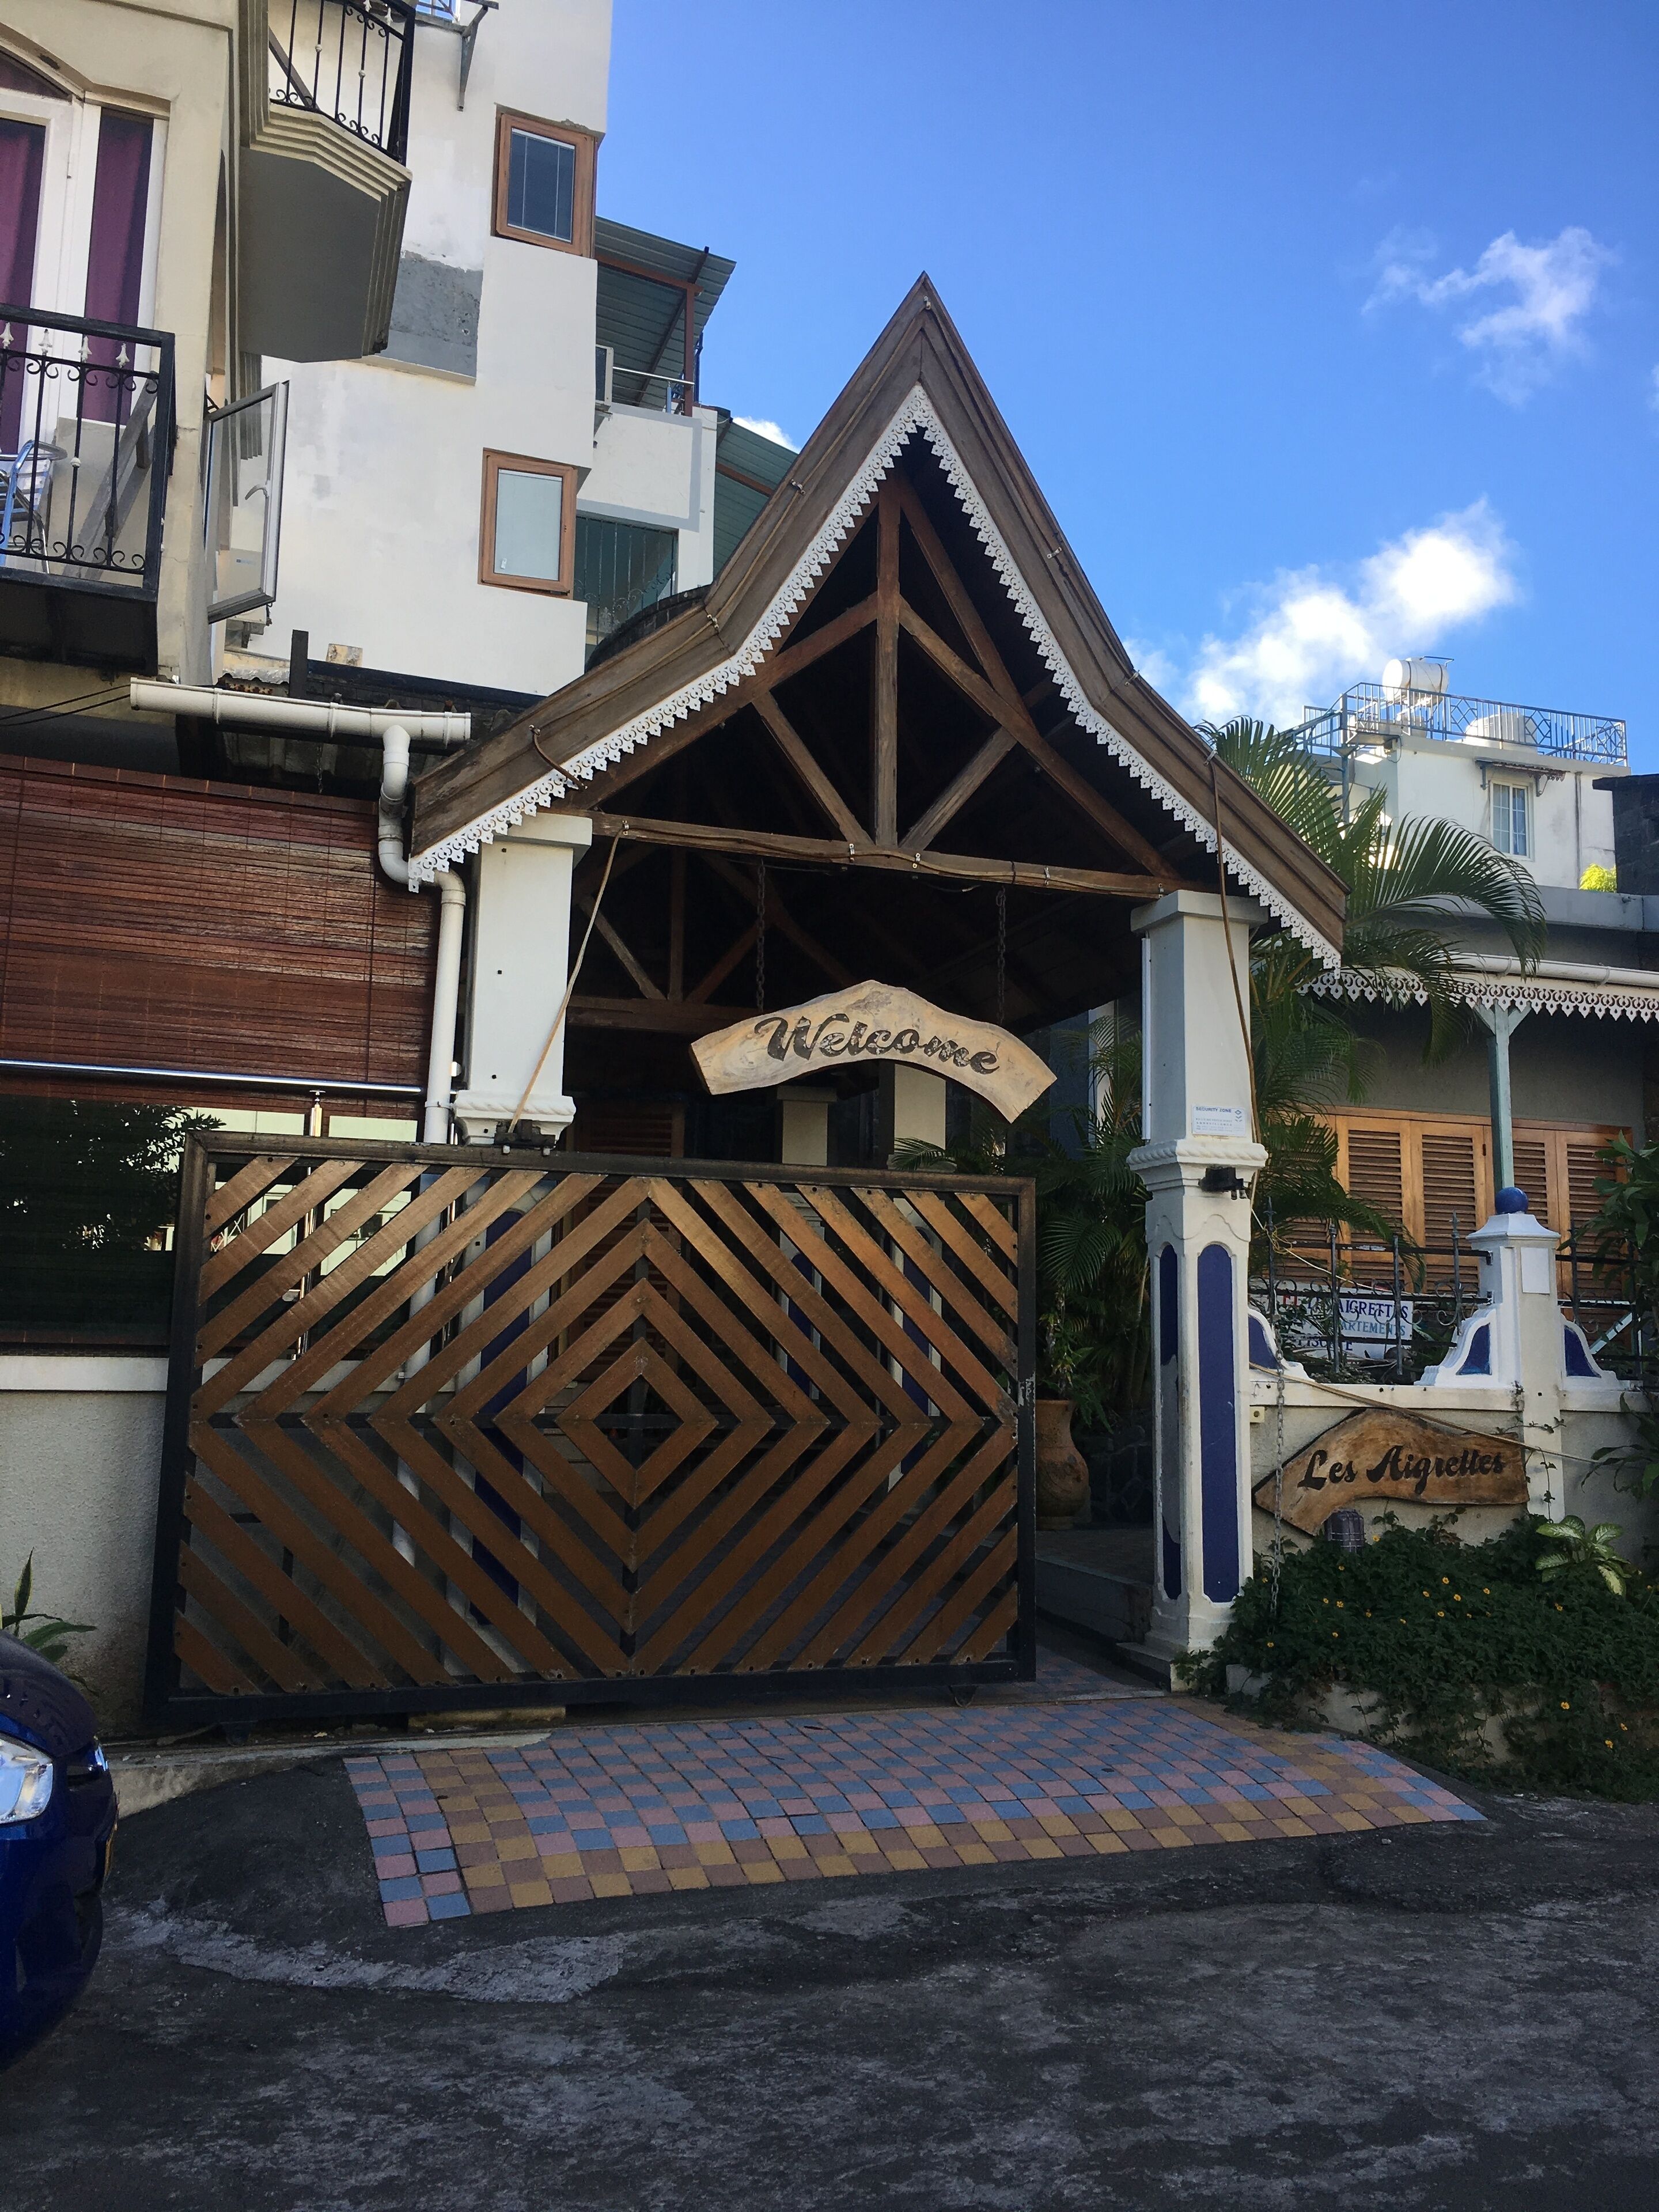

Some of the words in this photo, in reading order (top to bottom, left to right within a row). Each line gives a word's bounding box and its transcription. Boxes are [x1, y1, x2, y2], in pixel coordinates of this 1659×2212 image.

[755, 1013, 1000, 1074] Welcome
[1297, 1449, 1358, 1490] Les
[1366, 1444, 1506, 1494] Aigrettes
